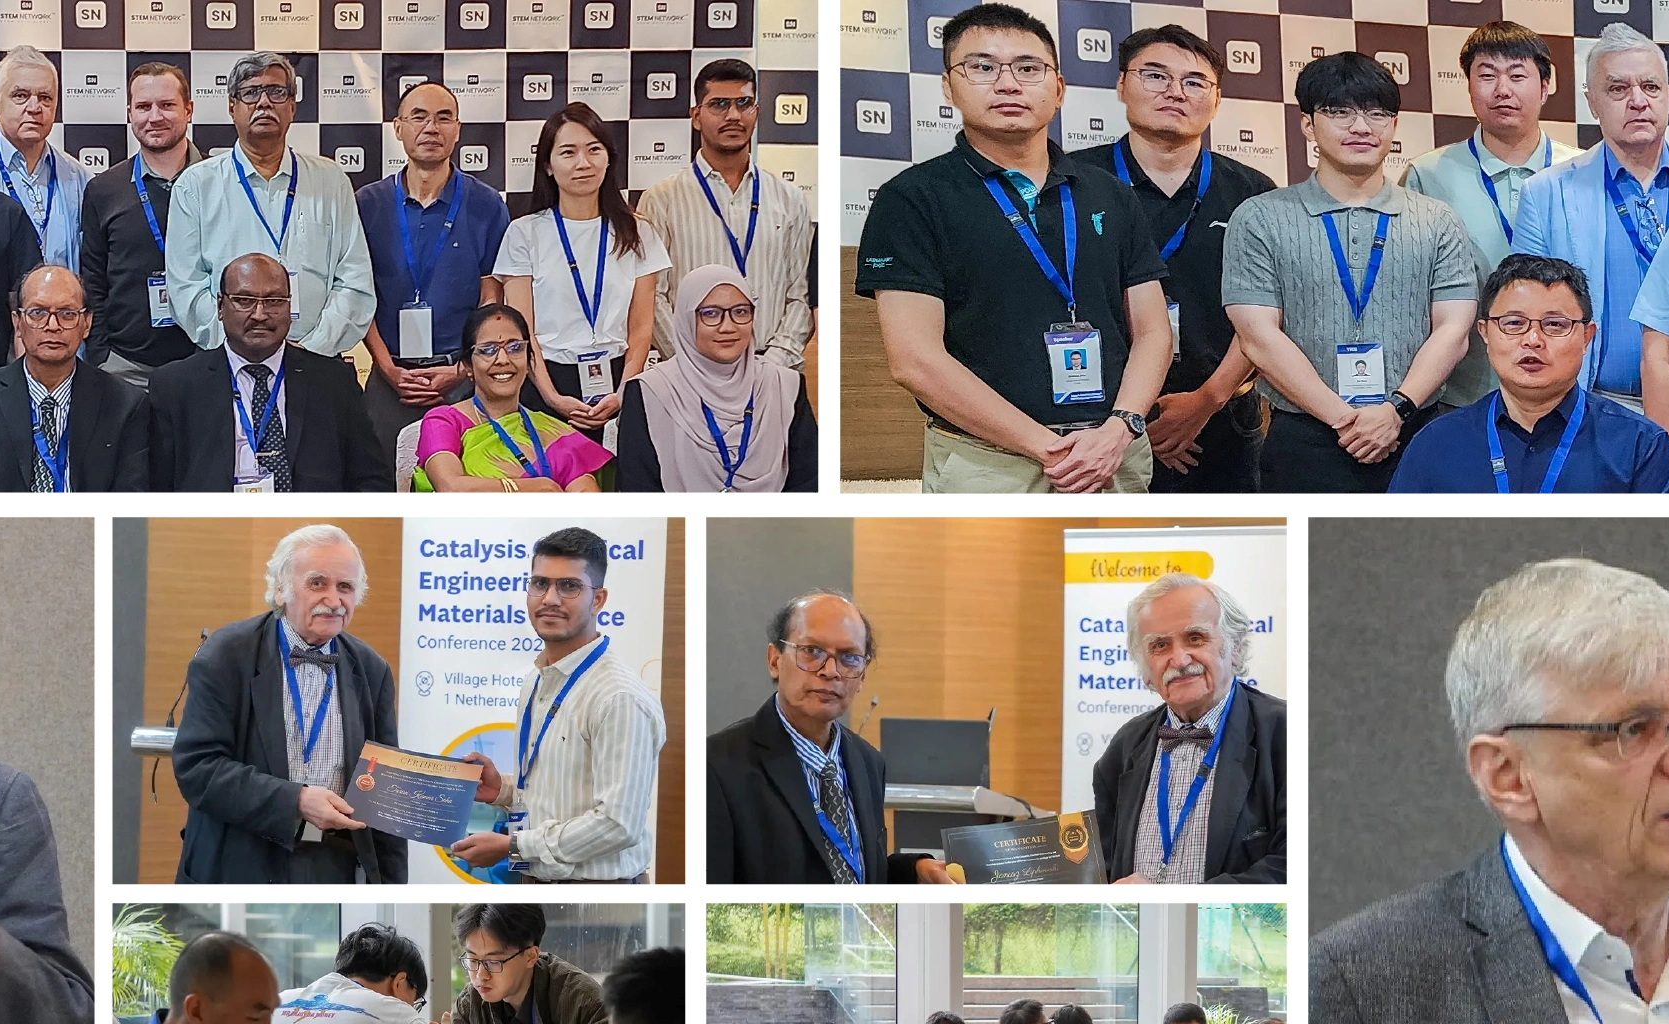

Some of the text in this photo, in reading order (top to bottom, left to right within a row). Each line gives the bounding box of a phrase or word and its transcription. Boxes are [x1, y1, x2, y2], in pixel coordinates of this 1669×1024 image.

[212, 10, 231, 21] SN
[465, 11, 484, 22] SN
[713, 10, 732, 21] SN
[1084, 38, 1106, 53] SN
[1232, 50, 1255, 64] SN
[528, 82, 547, 93] SN
[782, 104, 802, 115] SN
[863, 110, 885, 125] SN
[1217, 144, 1274, 154] STEM NETWORK
[85, 155, 104, 166] SN
[340, 154, 359, 165] SN
[1090, 559, 1160, 578] Welcome
[419, 604, 526, 624] Materials
[417, 634, 543, 652] Conference 202
[444, 672, 524, 689] Village Hote
[445, 693, 449, 704] 1
[1077, 700, 1156, 714] Conference
[994, 835, 1047, 848] CERTIFICATE
